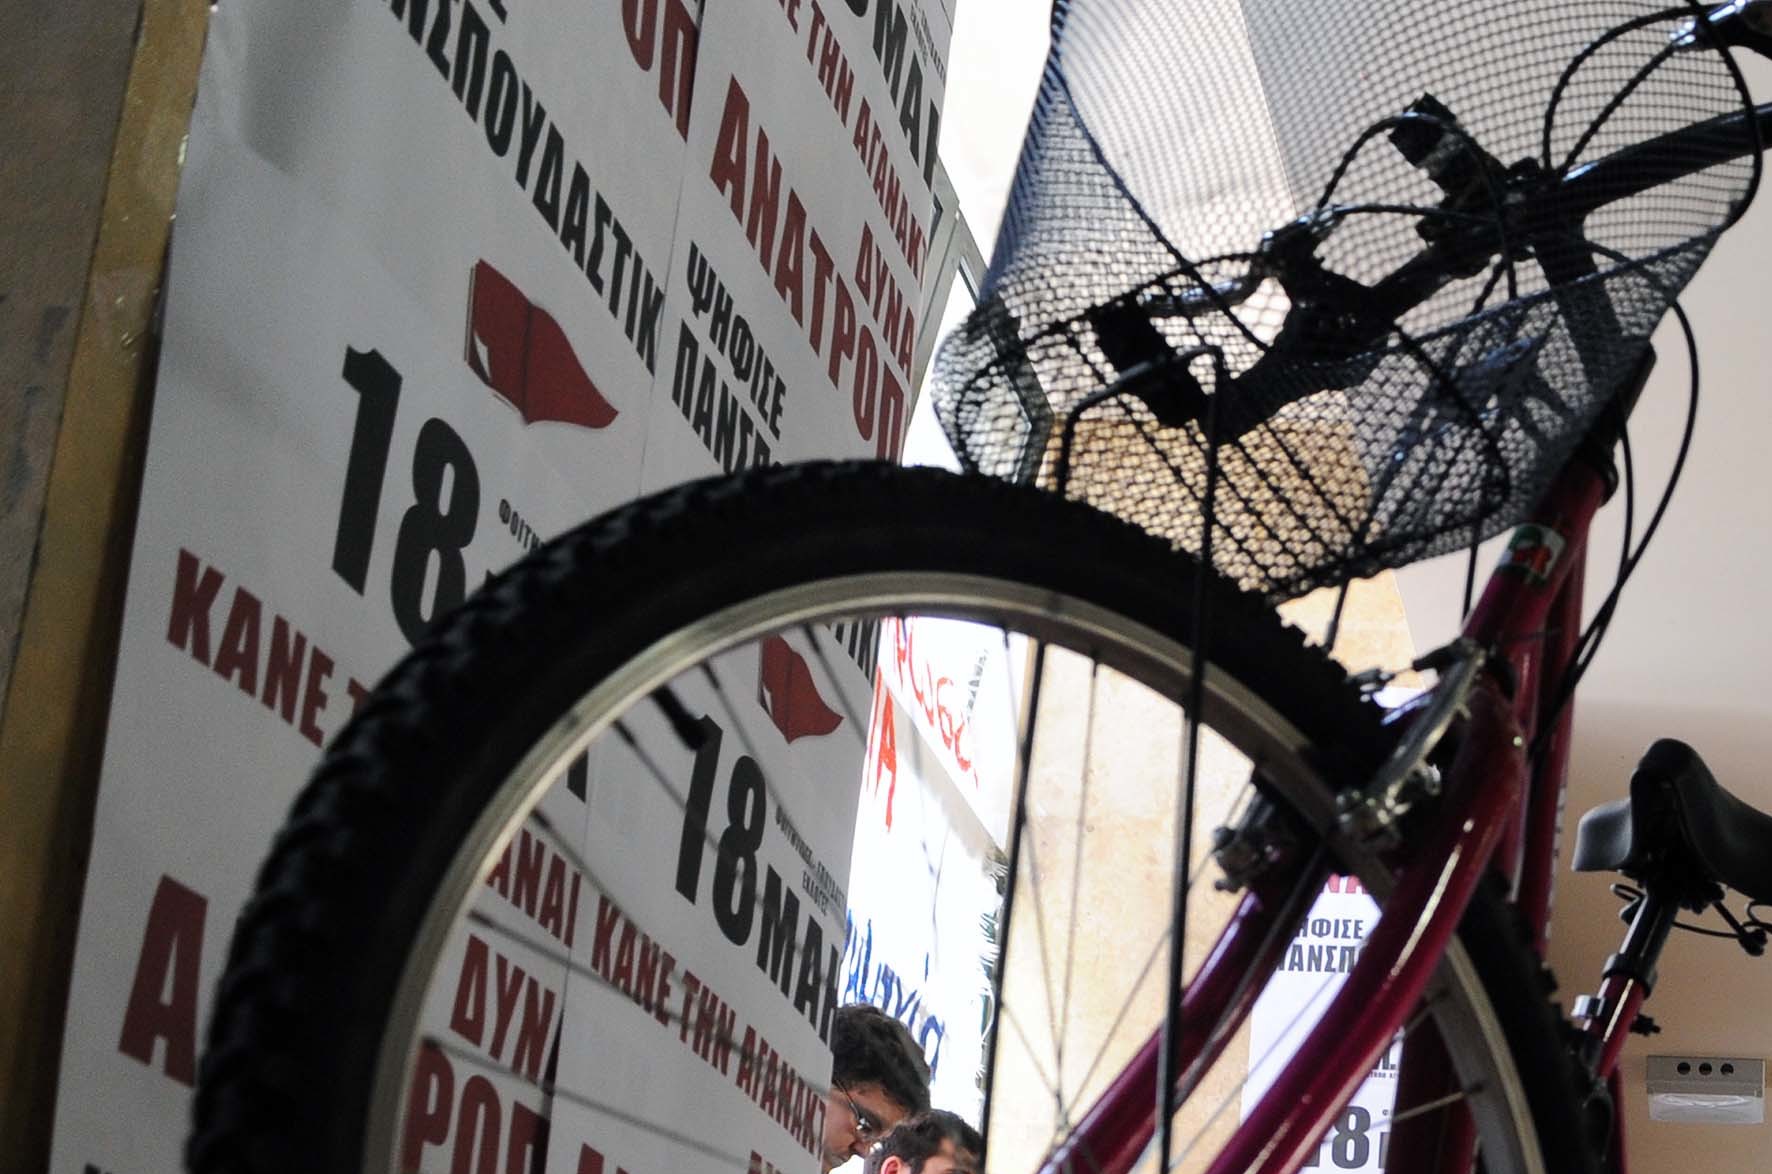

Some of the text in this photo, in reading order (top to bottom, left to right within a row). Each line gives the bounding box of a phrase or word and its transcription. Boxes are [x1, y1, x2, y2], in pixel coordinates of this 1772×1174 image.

[687, 240, 787, 441] ΨΗΦΙΣΕ
[331, 345, 481, 650] 18
[167, 548, 335, 748] ΚΑΝΕ
[592, 894, 677, 1028] ΚΑΝΕ
[680, 969, 736, 1077] ΤΗΝ
